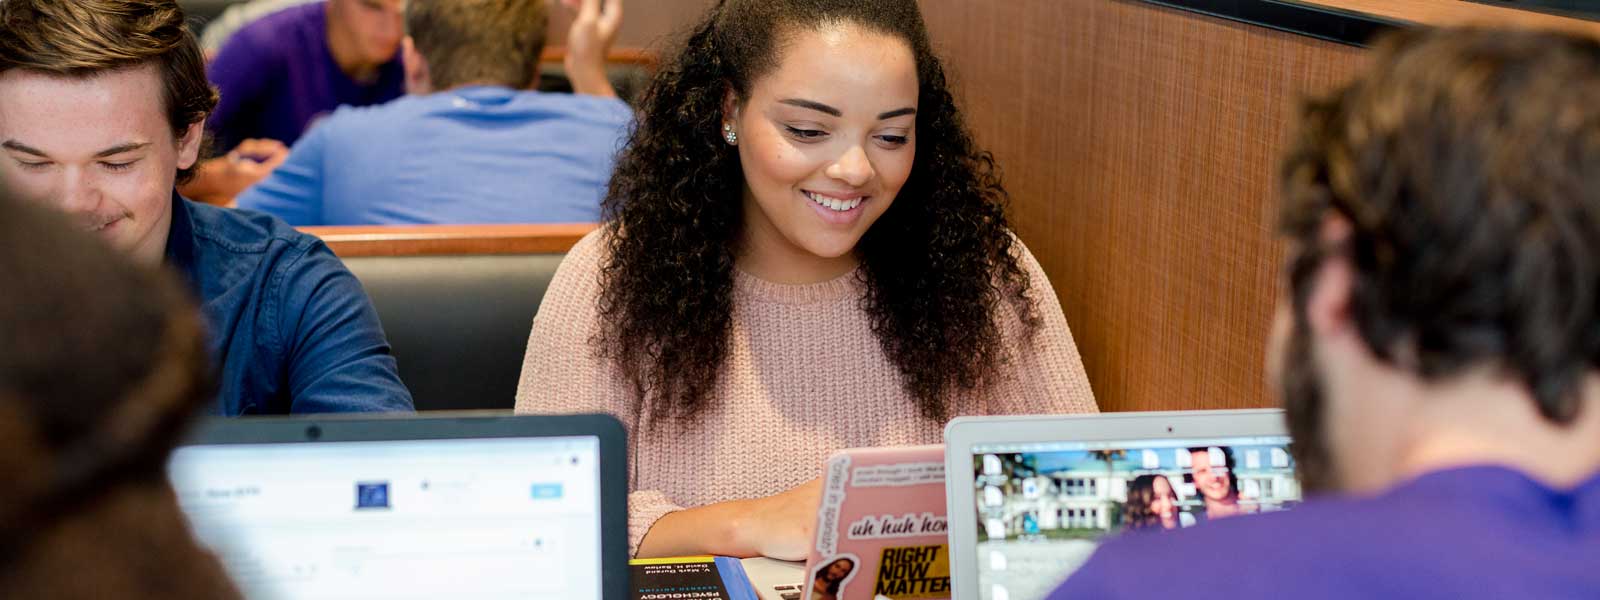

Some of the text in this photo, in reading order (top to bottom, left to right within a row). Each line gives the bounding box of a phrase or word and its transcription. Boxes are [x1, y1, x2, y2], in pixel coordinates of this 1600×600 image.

[852, 520, 873, 536] uh
[881, 517, 914, 534] huh
[882, 545, 941, 565] RIGHT
[878, 562, 930, 581] NOW
[875, 576, 951, 595] MATTER
[640, 592, 719, 600] PSYCHOLOGY
